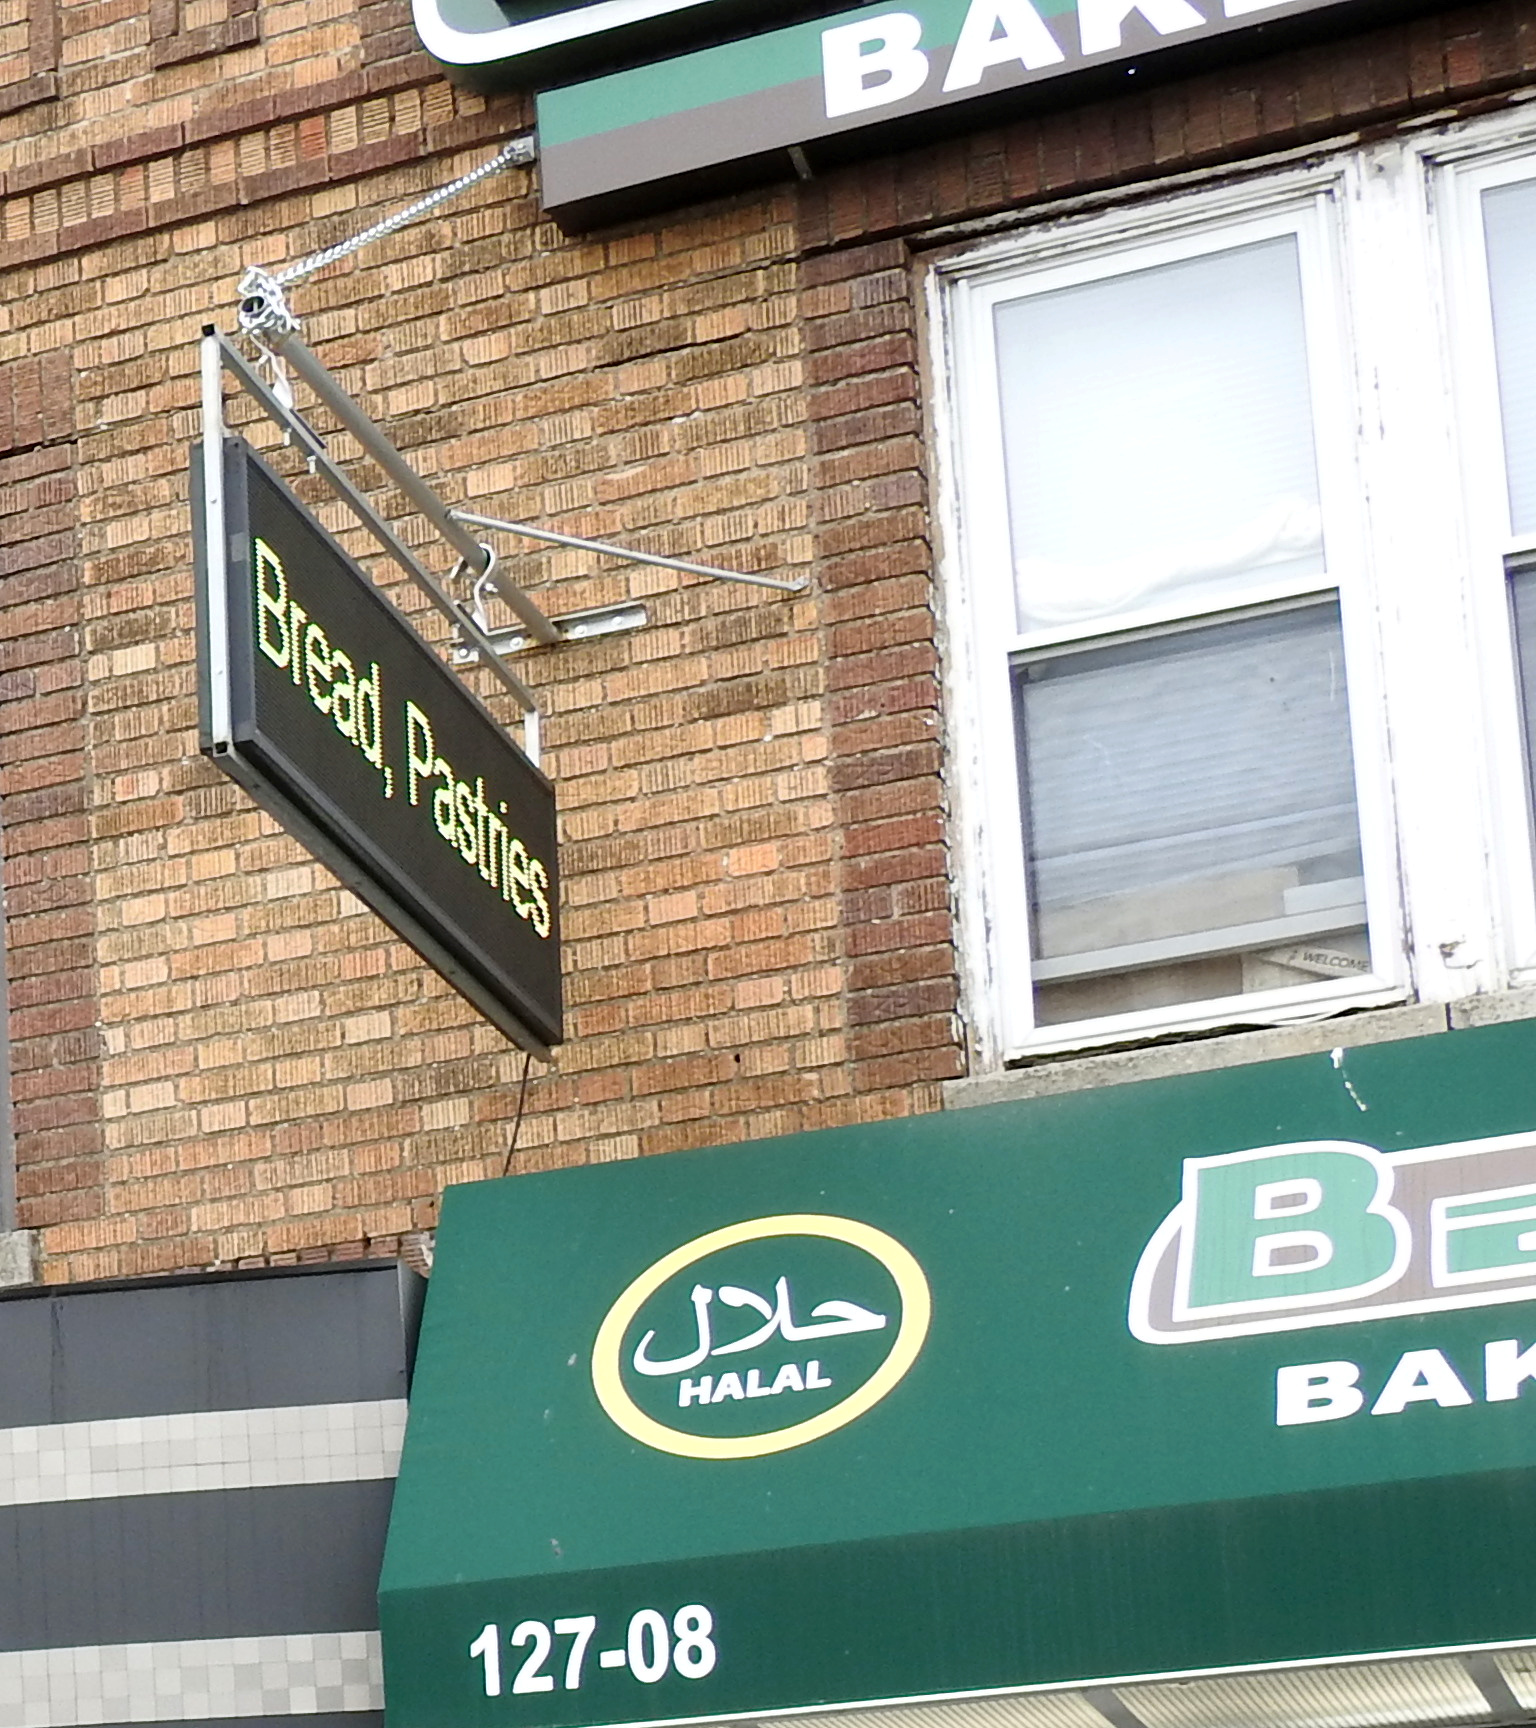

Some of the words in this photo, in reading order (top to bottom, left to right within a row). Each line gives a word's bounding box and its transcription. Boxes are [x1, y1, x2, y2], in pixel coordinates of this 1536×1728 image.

[255, 537, 394, 799] Bread,
[405, 700, 551, 939] Pastries
[1303, 951, 1370, 971] WELCOME
[633, 1276, 887, 1376] حلال
[678, 1360, 832, 1407] HALAL
[469, 1604, 717, 1697] 127-08
